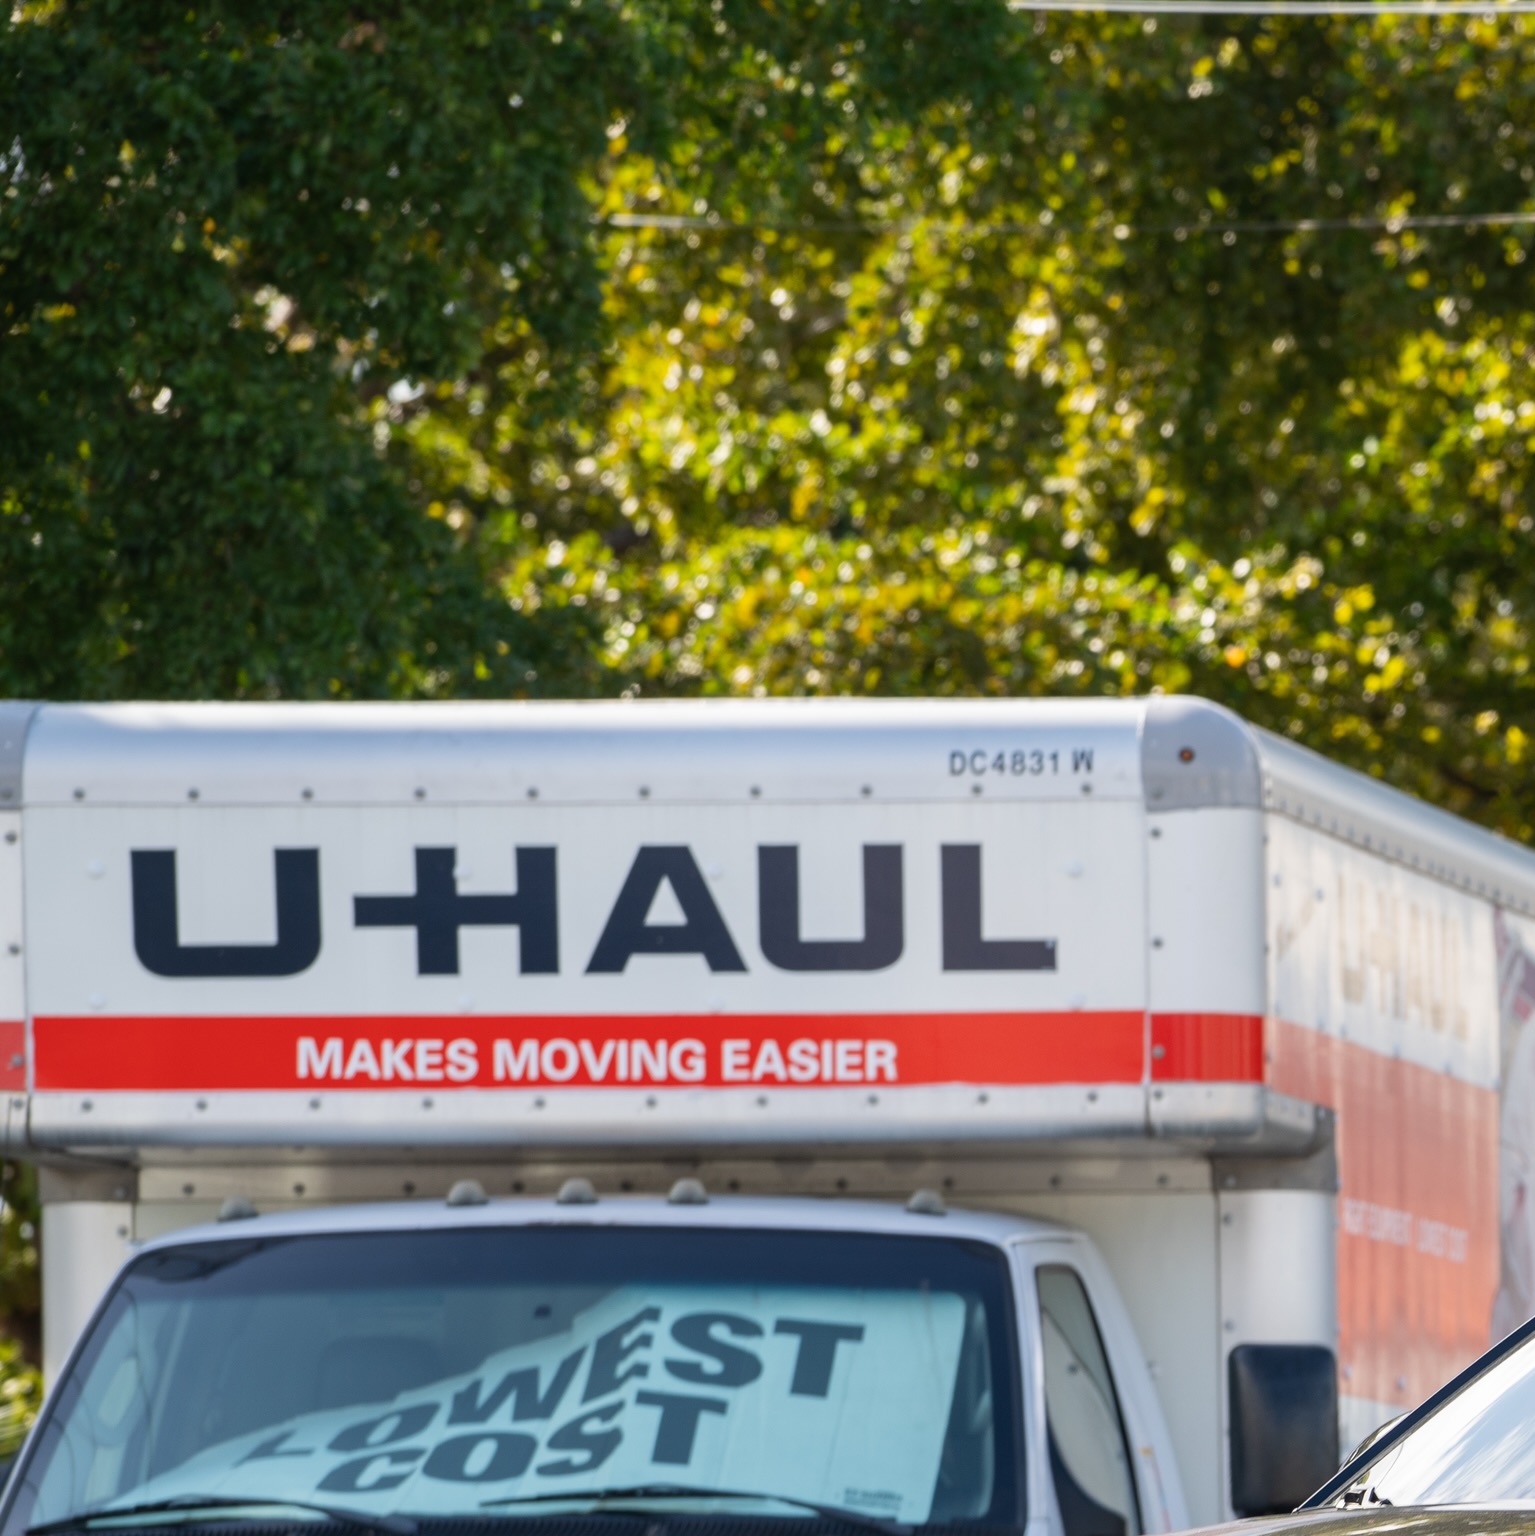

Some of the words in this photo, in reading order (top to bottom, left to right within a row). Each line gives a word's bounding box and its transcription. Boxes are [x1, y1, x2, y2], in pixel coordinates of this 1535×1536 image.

[948, 749, 1060, 777] DC4831
[1071, 748, 1095, 774] W
[129, 843, 1059, 978] U-HAUL
[295, 1036, 479, 1081] MAKES
[492, 1038, 707, 1082] MOVING
[720, 1039, 899, 1082] EASIER
[231, 1305, 866, 1468] LOWEST
[315, 1389, 729, 1493] COST
